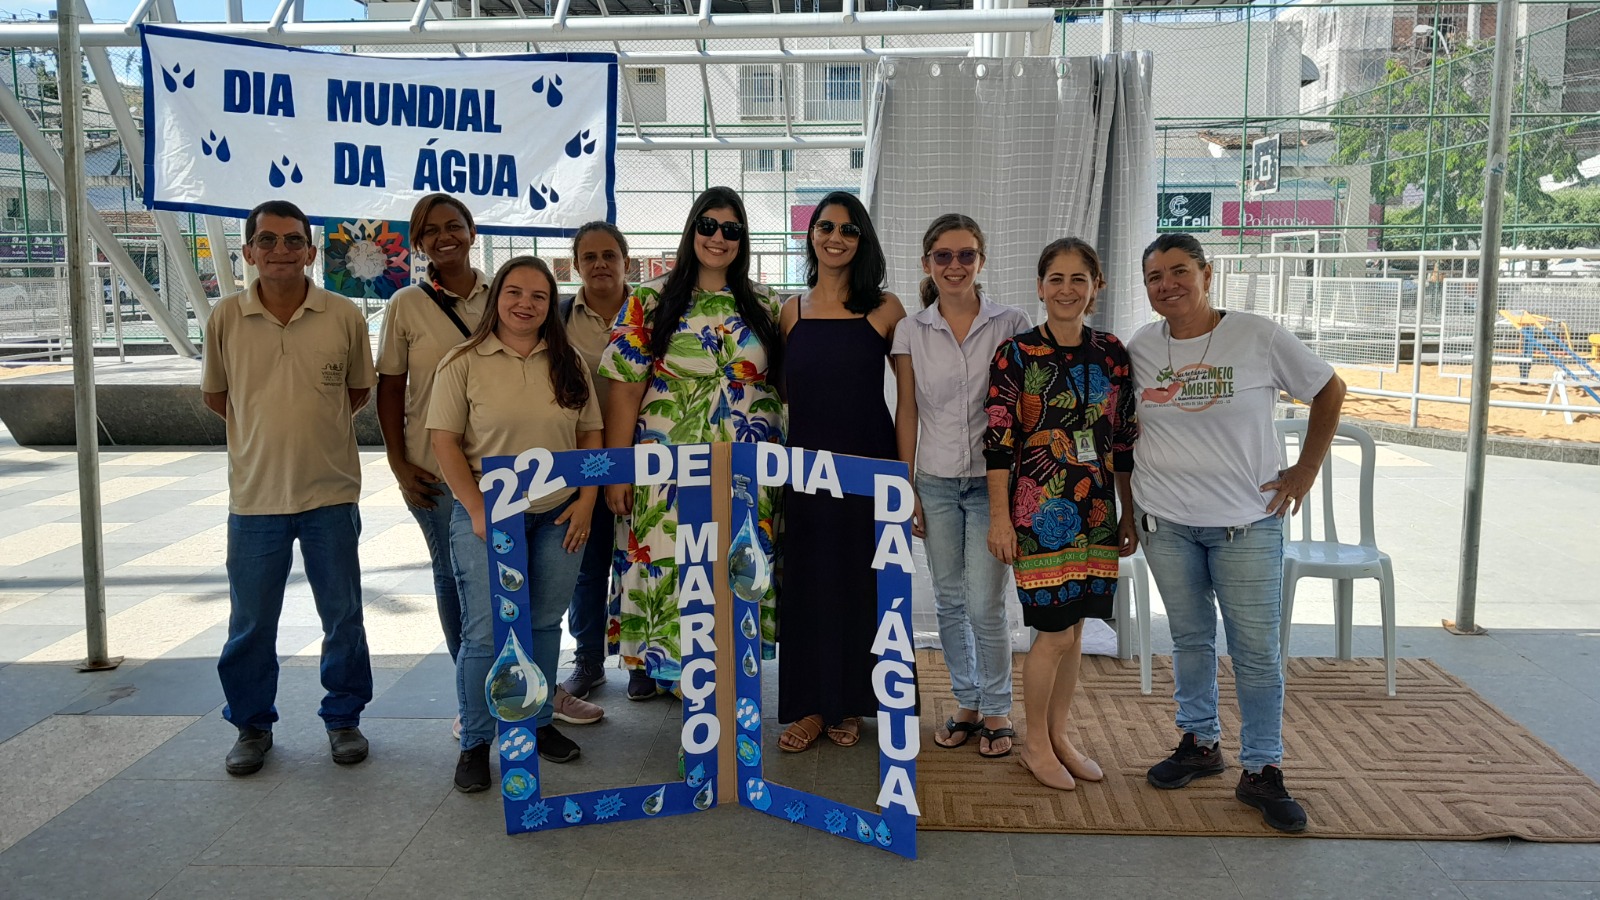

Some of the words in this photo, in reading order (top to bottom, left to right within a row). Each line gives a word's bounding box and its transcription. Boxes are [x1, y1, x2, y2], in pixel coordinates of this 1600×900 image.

[223, 69, 295, 118] DIA
[327, 78, 502, 133] MUNDIAL
[334, 142, 386, 188] DA
[413, 138, 518, 197] ÁGUA
[1181, 381, 1234, 396] AMBIENTE
[1207, 366, 1233, 380] MEIO
[479, 447, 567, 524] 22
[634, 443, 710, 487] DE
[756, 441, 845, 499] DIA
[871, 474, 917, 574] DA
[674, 521, 721, 755] MARÇO
[869, 596, 921, 817] ÁGUA
